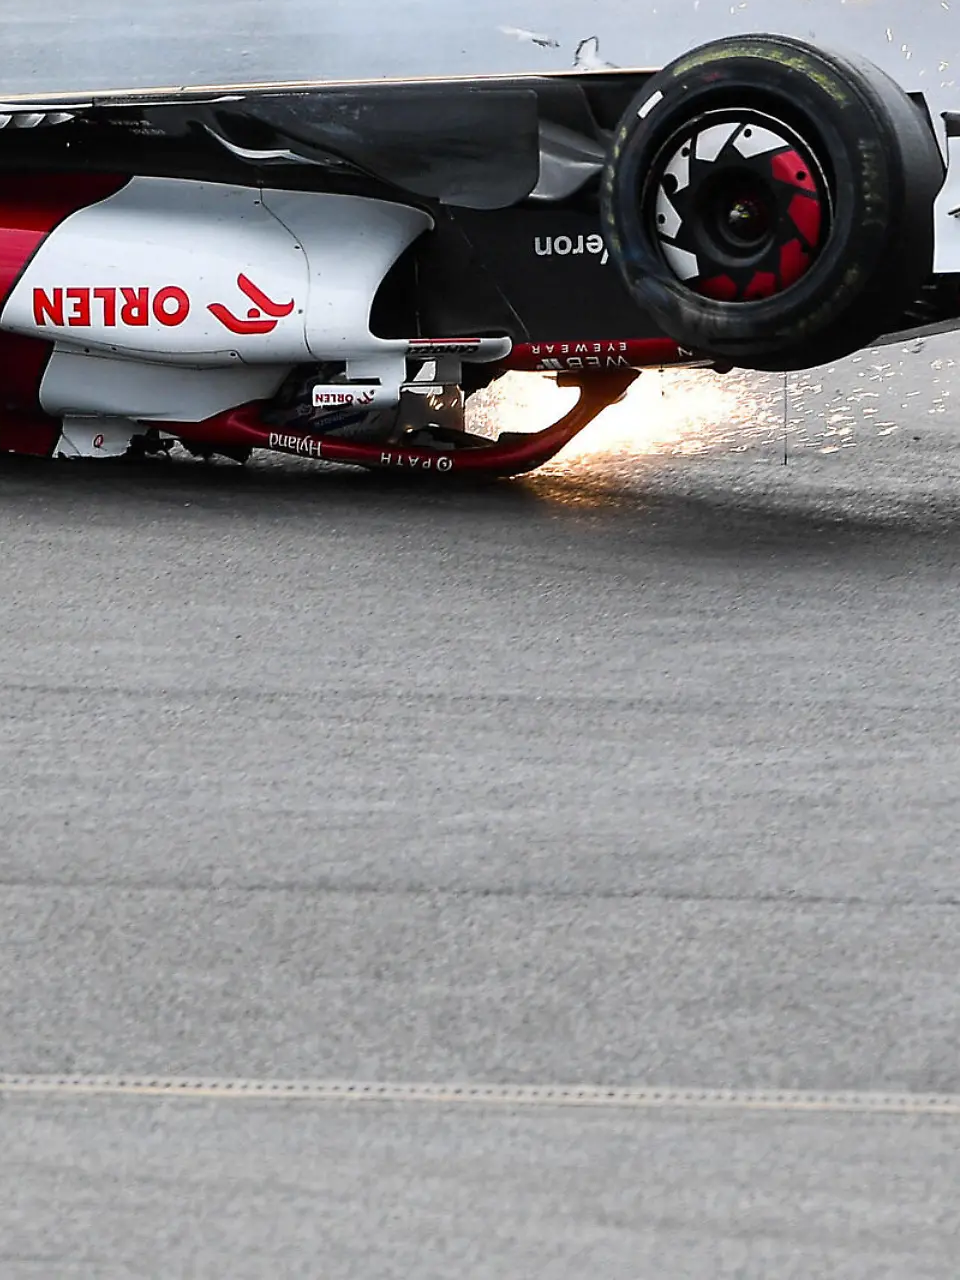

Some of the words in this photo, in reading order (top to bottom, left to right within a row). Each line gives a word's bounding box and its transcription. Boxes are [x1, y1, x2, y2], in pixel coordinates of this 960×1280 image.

[33, 285, 190, 327] ORLEN
[531, 342, 629, 355] EYEWEAR
[314, 391, 355, 405] ORLEN
[269, 431, 322, 459] Hyland
[379, 451, 432, 470] PATH
